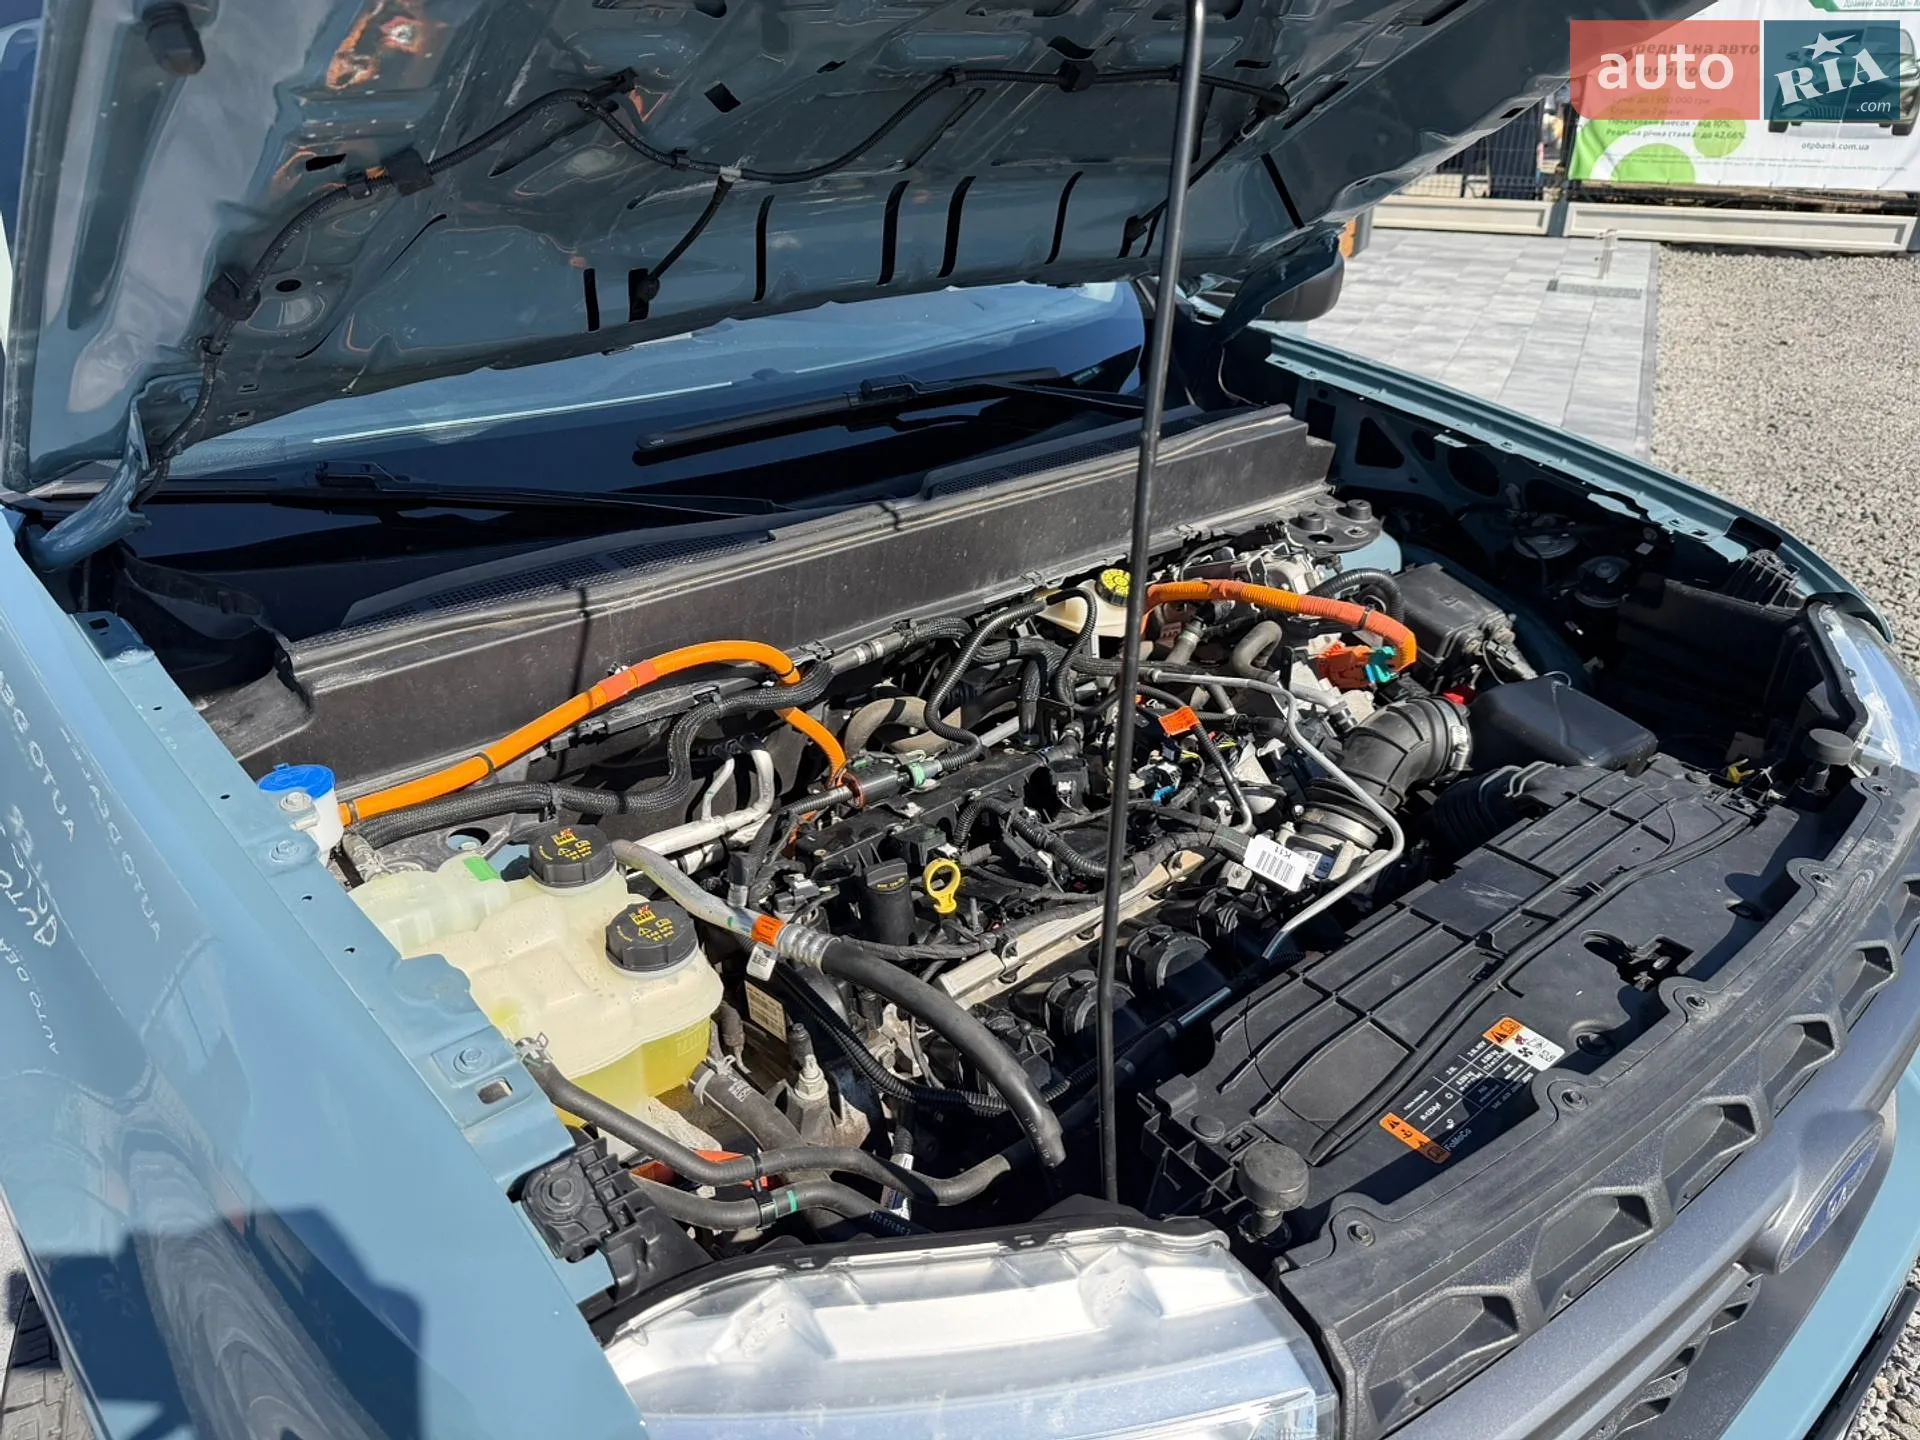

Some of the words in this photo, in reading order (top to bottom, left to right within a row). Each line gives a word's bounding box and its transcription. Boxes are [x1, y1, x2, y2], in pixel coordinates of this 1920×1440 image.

[1692, 43, 1714, 55] на
[1717, 43, 1760, 56] авто
[1801, 142, 1870, 152] otpbank.com.ua
